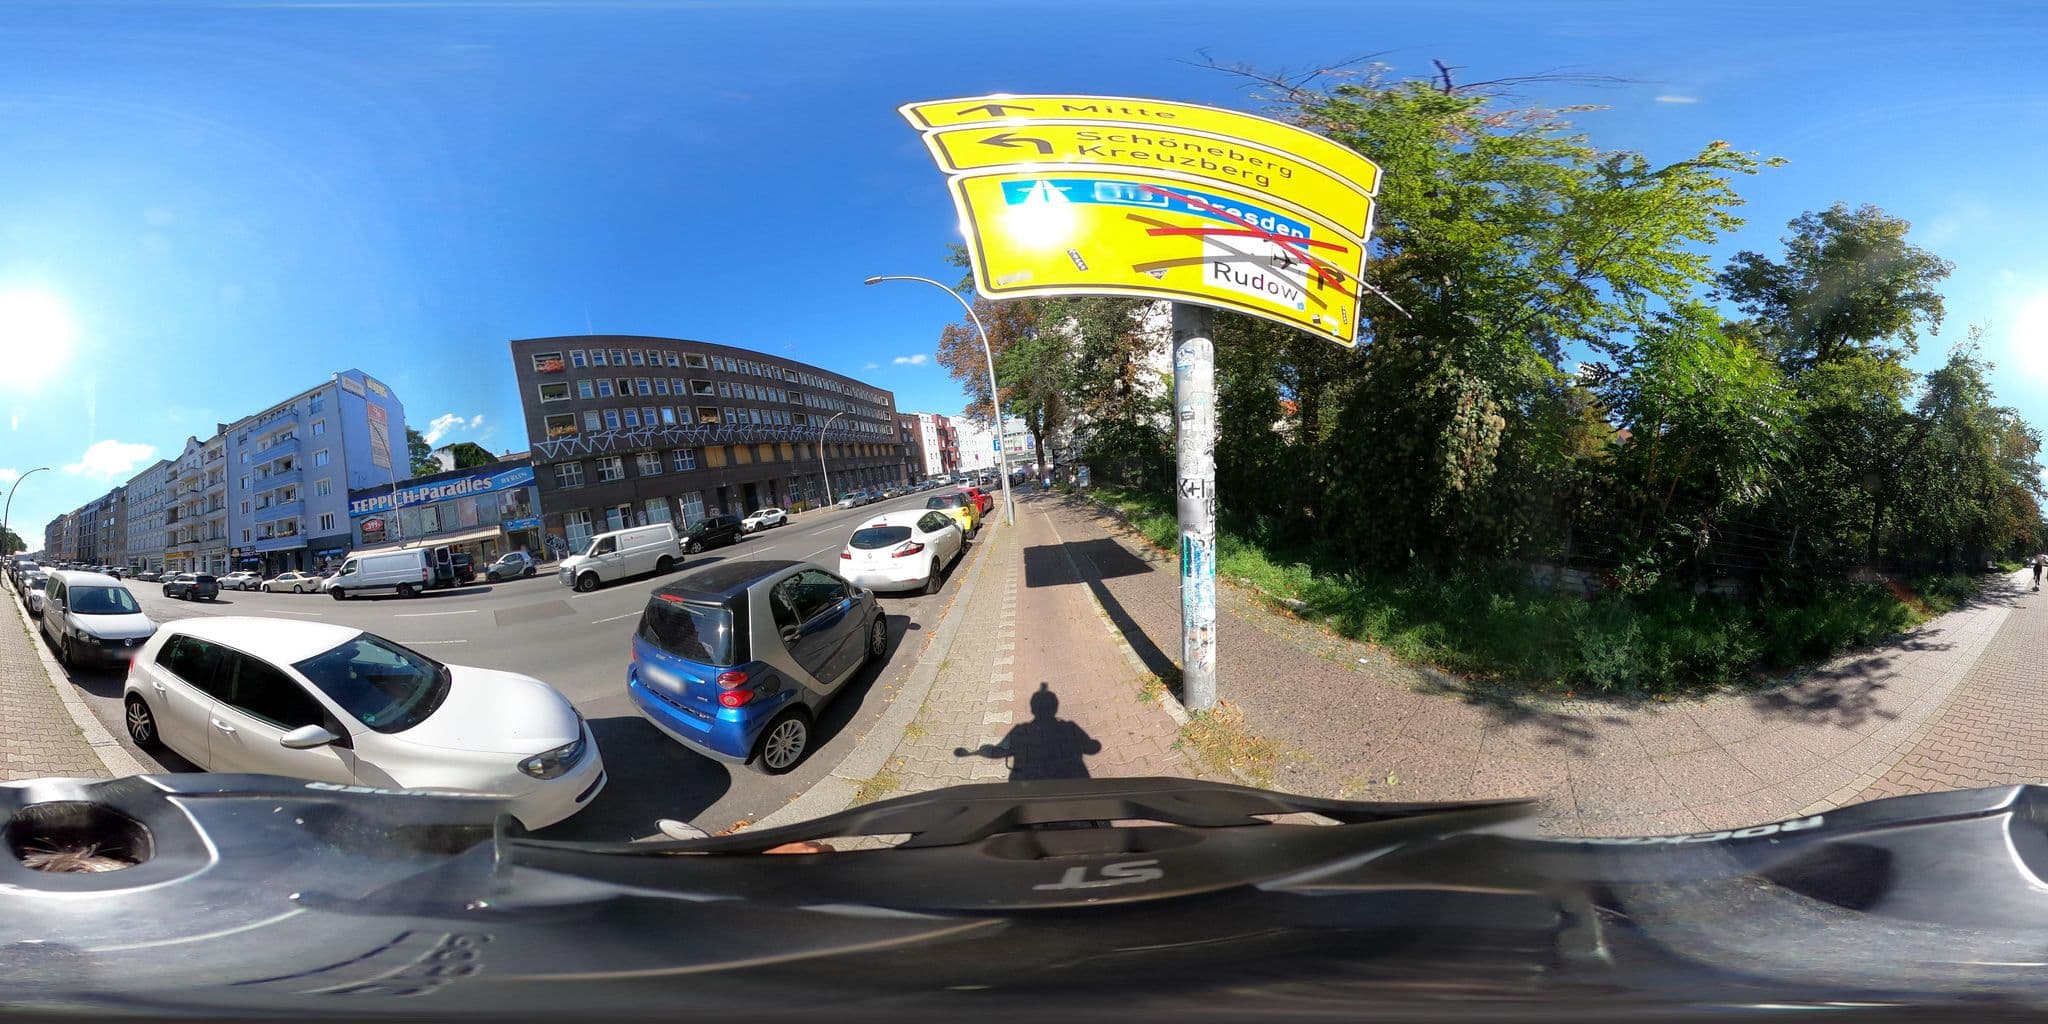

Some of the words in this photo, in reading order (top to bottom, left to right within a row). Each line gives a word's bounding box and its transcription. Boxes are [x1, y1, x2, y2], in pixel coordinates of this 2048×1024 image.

[1062, 104, 1176, 119] Mitte
[1076, 130, 1293, 179] Schöneberg
[1078, 144, 1270, 188] Kreuzberg
[1213, 261, 1298, 302] Rudow
